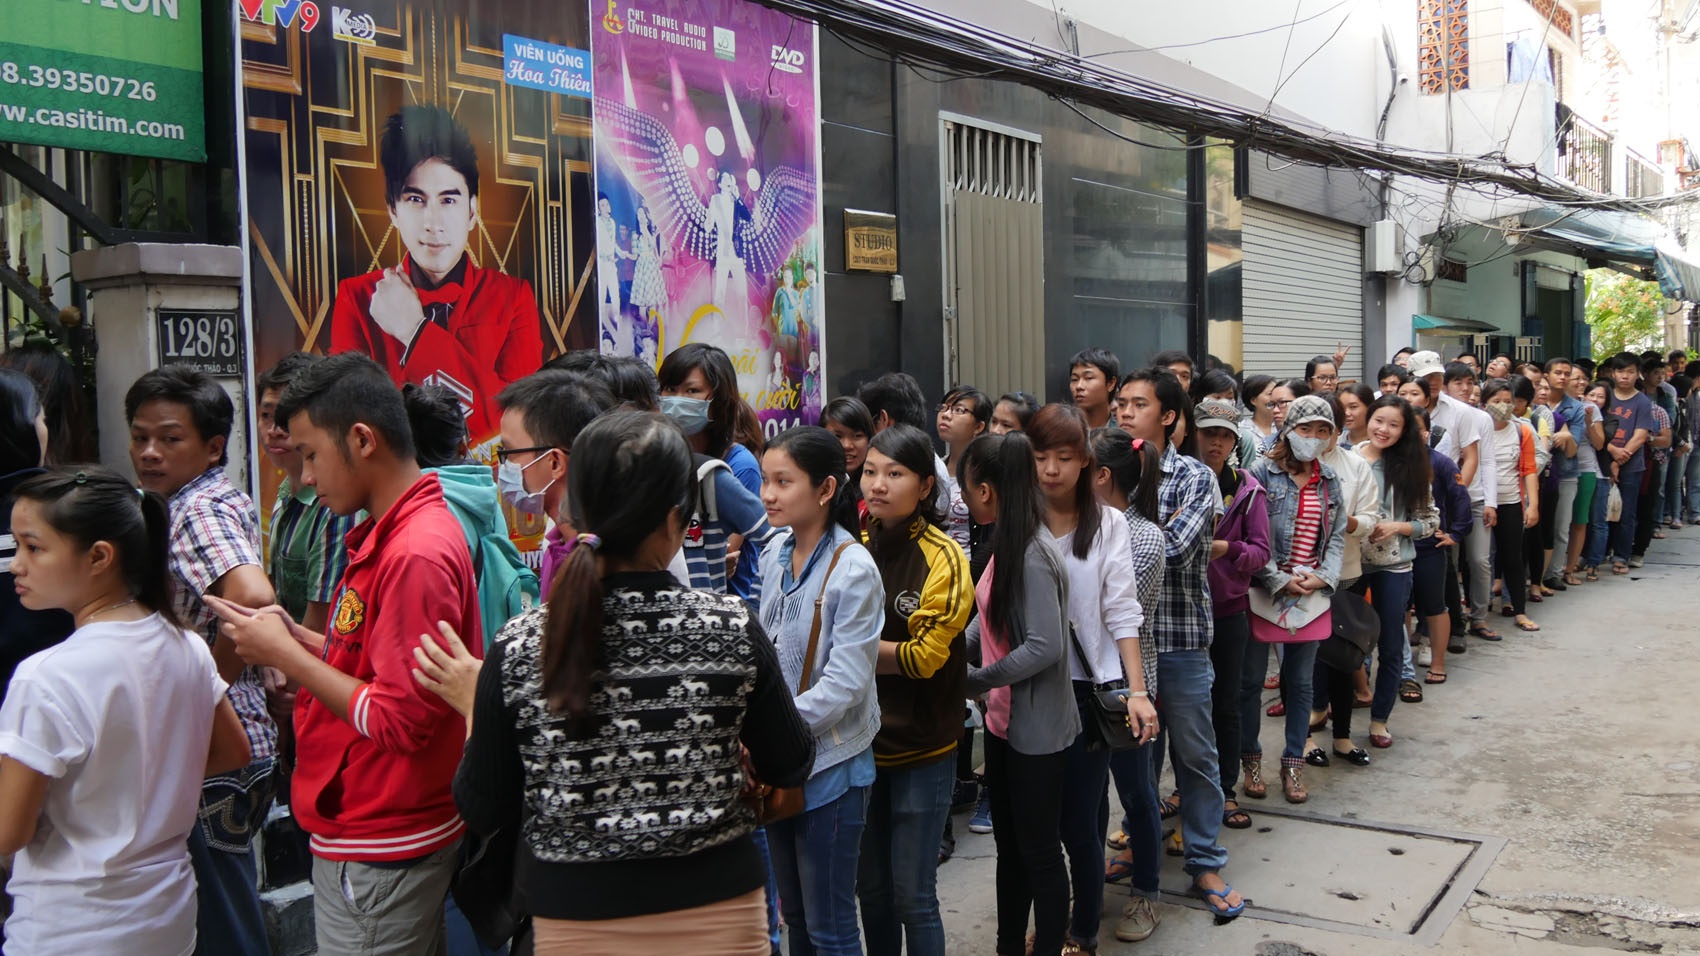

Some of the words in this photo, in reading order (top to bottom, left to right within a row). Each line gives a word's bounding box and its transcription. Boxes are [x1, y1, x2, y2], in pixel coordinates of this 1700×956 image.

[635, 23, 658, 40] VIDEO
[661, 30, 707, 51] PRODUCTION
[652, 14, 679, 31] TRAVEL
[683, 22, 706, 38] AUDIO
[513, 43, 544, 61] VIÊN
[547, 49, 584, 69] UỐNG
[771, 44, 805, 66] DVD
[0, 61, 157, 102] 8.39350726
[507, 59, 545, 84] Hoa
[548, 67, 591, 93] Thiên
[0, 104, 185, 141] w.casitim.com
[854, 232, 893, 251] STUDIO
[164, 316, 236, 358] 128/3
